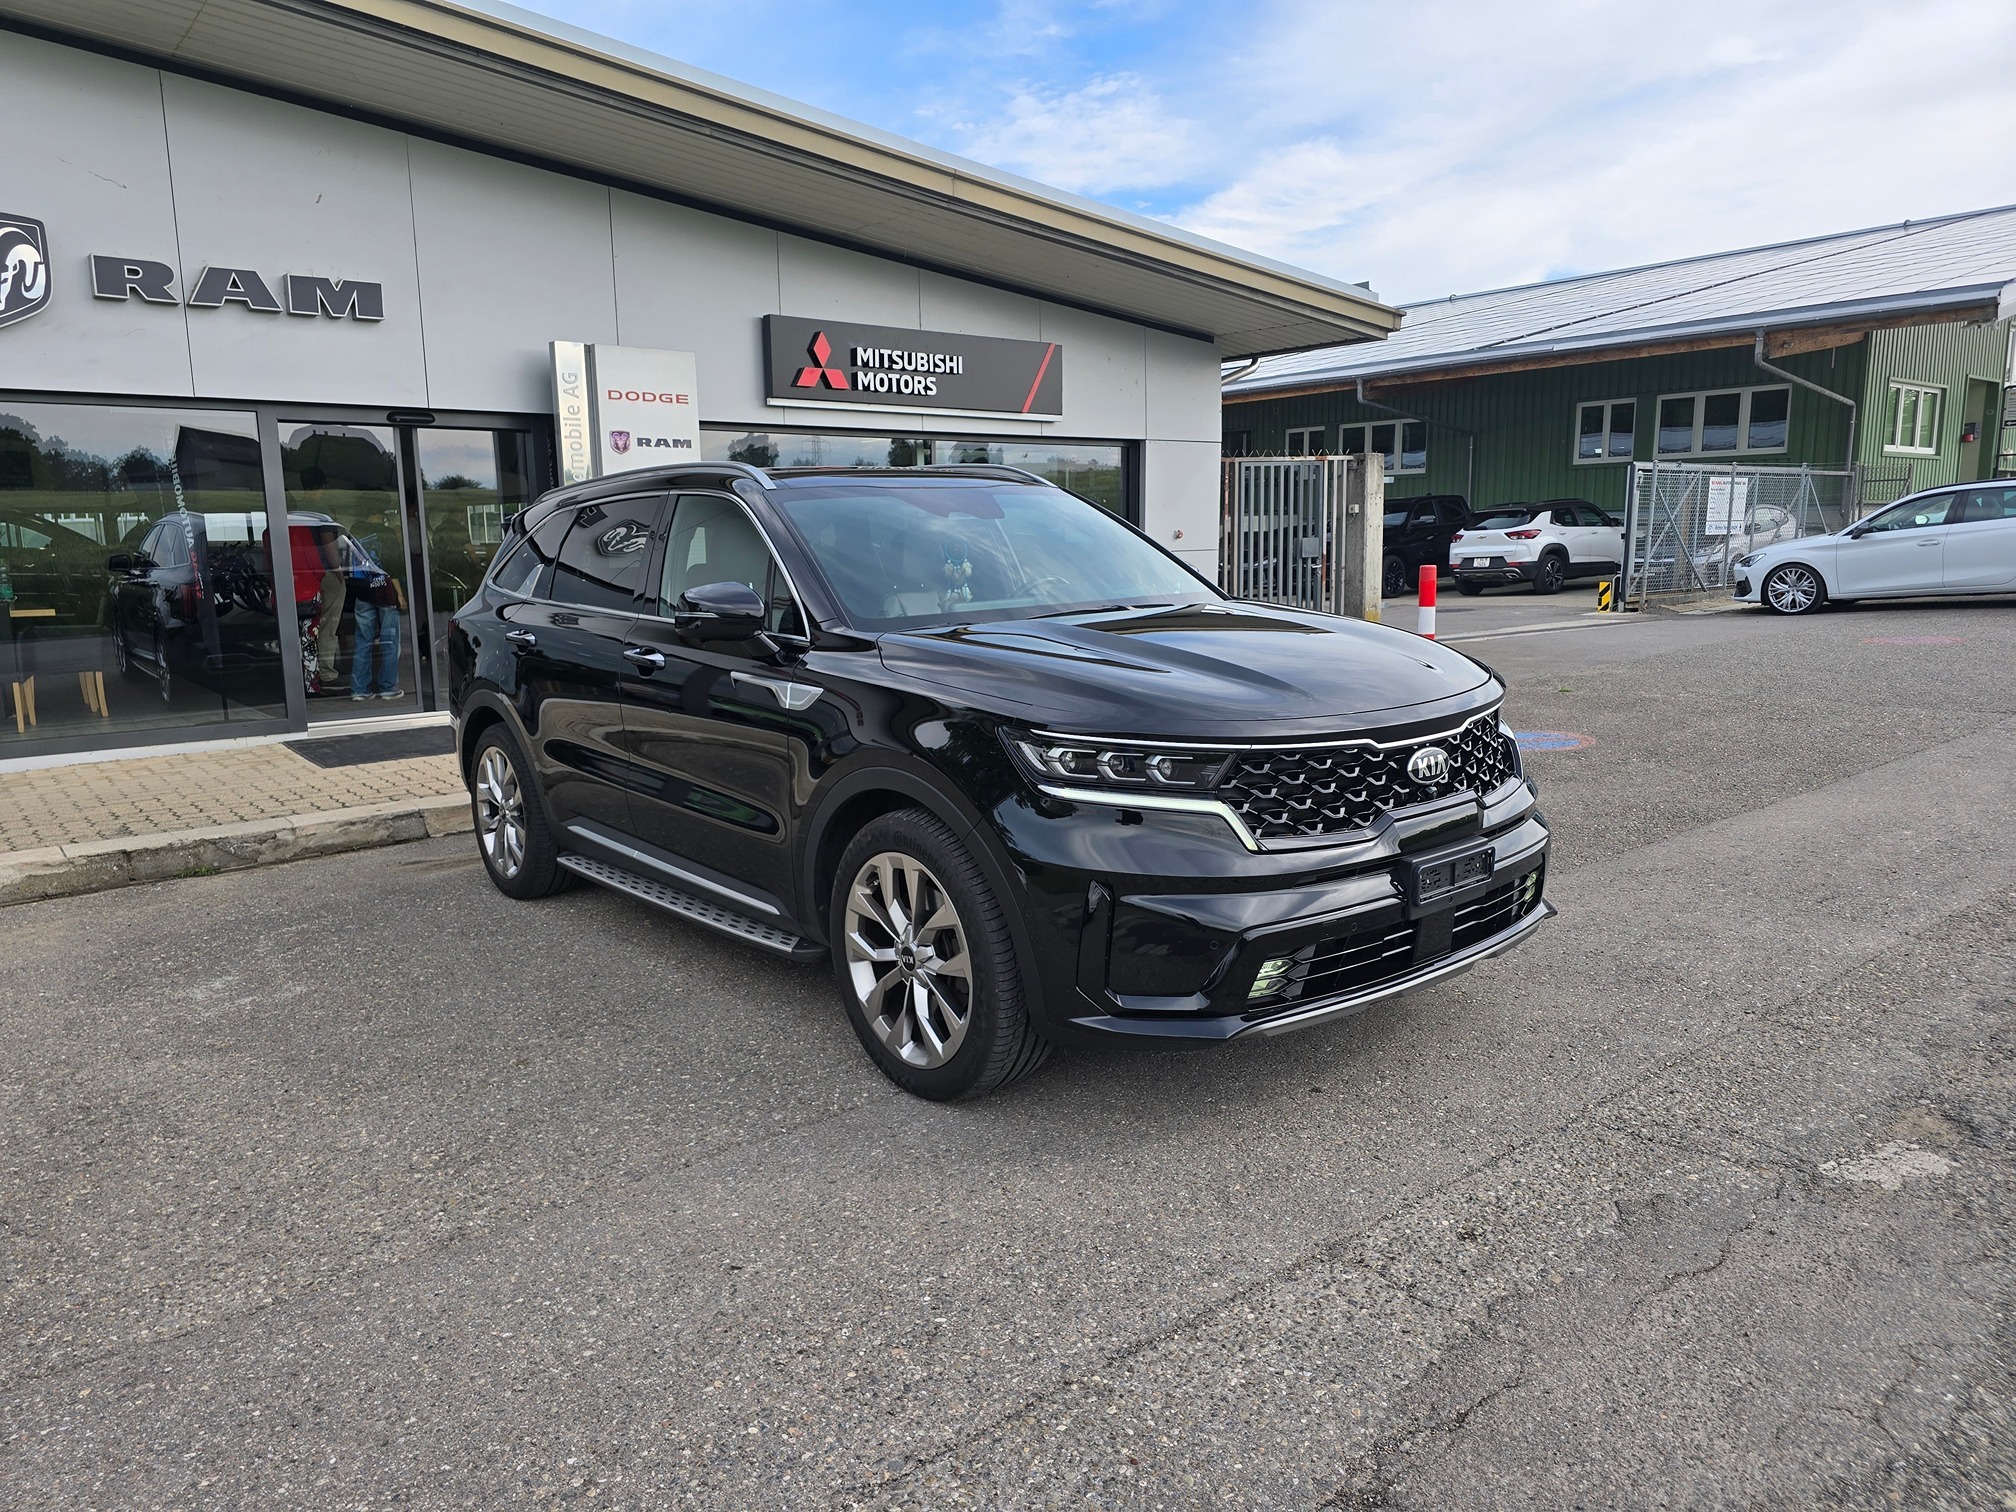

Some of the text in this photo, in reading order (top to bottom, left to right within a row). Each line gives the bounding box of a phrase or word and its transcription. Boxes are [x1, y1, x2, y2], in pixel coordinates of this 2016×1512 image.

[88, 253, 385, 322] RAM
[855, 346, 963, 375] MITSUBISHI
[562, 372, 580, 398] AG
[856, 371, 938, 396] MOTORS
[607, 390, 690, 405] DODGE
[637, 437, 692, 449] RAM
[1416, 754, 1447, 778] KIA
[893, 831, 947, 879] Continental
[901, 954, 914, 964] KIA
